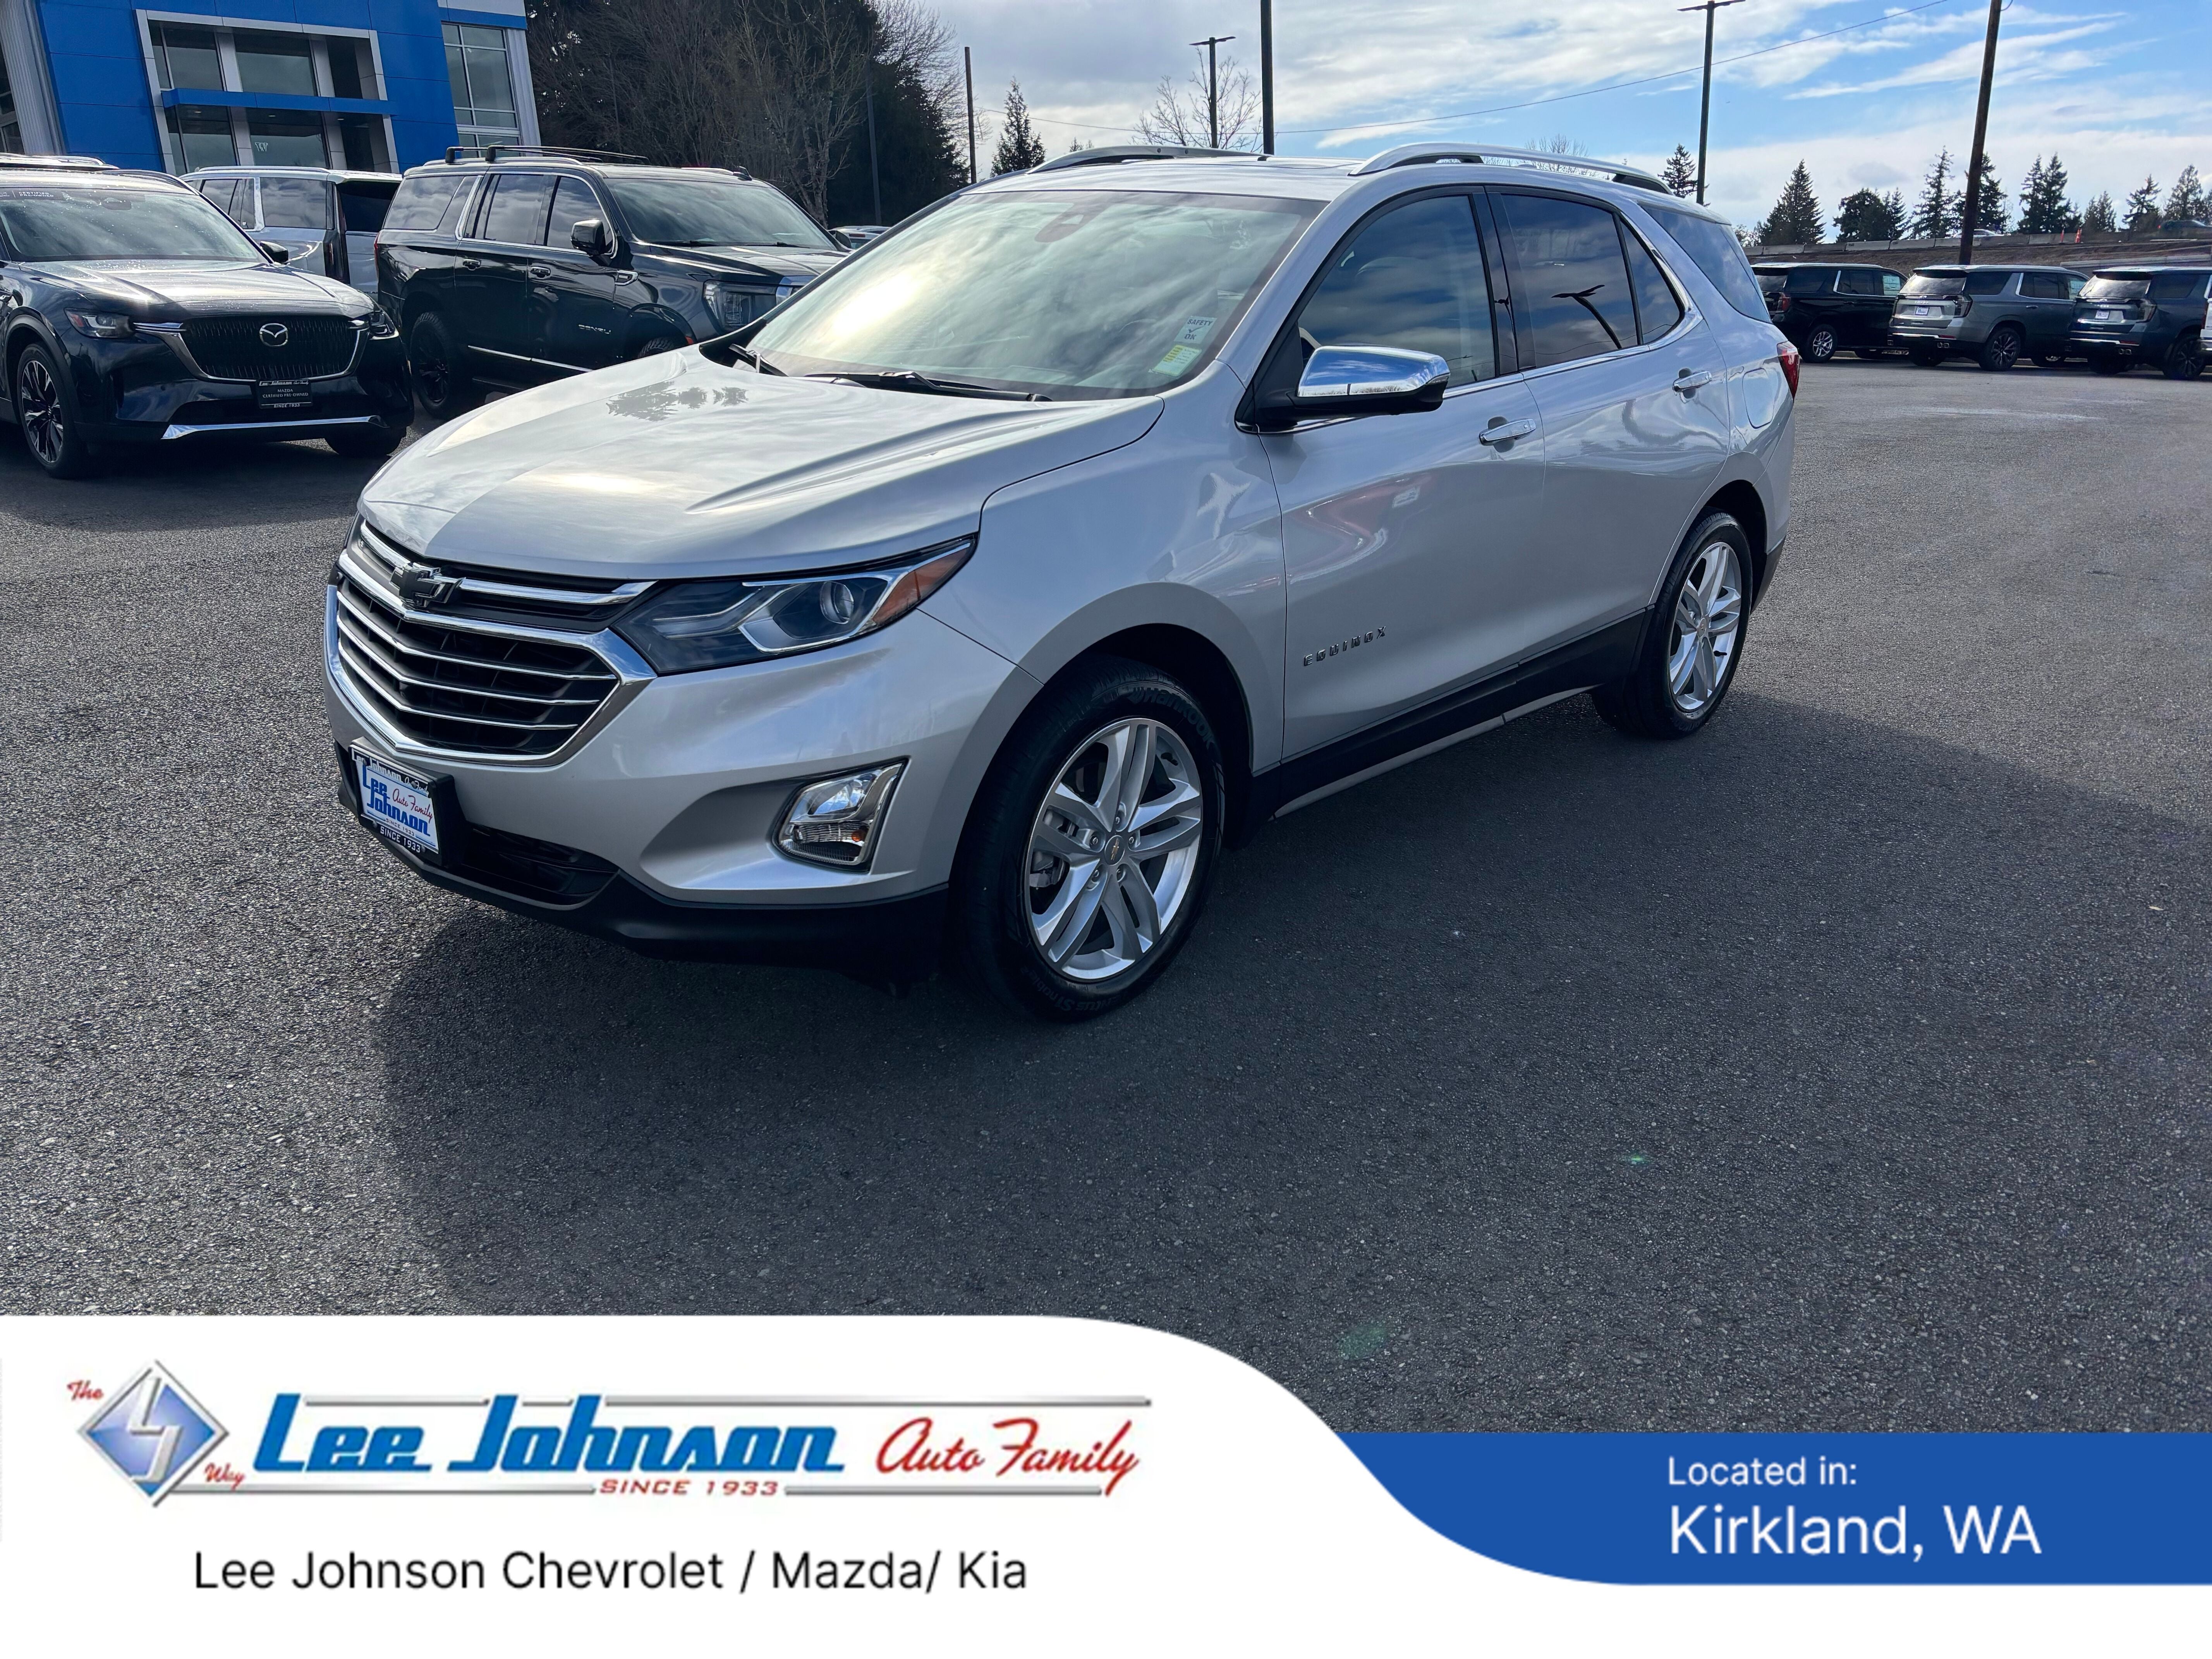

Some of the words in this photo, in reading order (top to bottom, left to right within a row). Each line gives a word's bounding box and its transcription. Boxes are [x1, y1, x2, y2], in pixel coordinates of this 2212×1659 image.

[1304, 626, 1386, 666] EQUINOX
[363, 764, 390, 799] Lee
[367, 790, 431, 836] Johnson
[393, 788, 408, 807] Auto
[409, 795, 433, 823] Family
[380, 827, 400, 843] SINCE
[404, 838, 421, 853] 1933
[385, 817, 400, 830] SINCE
